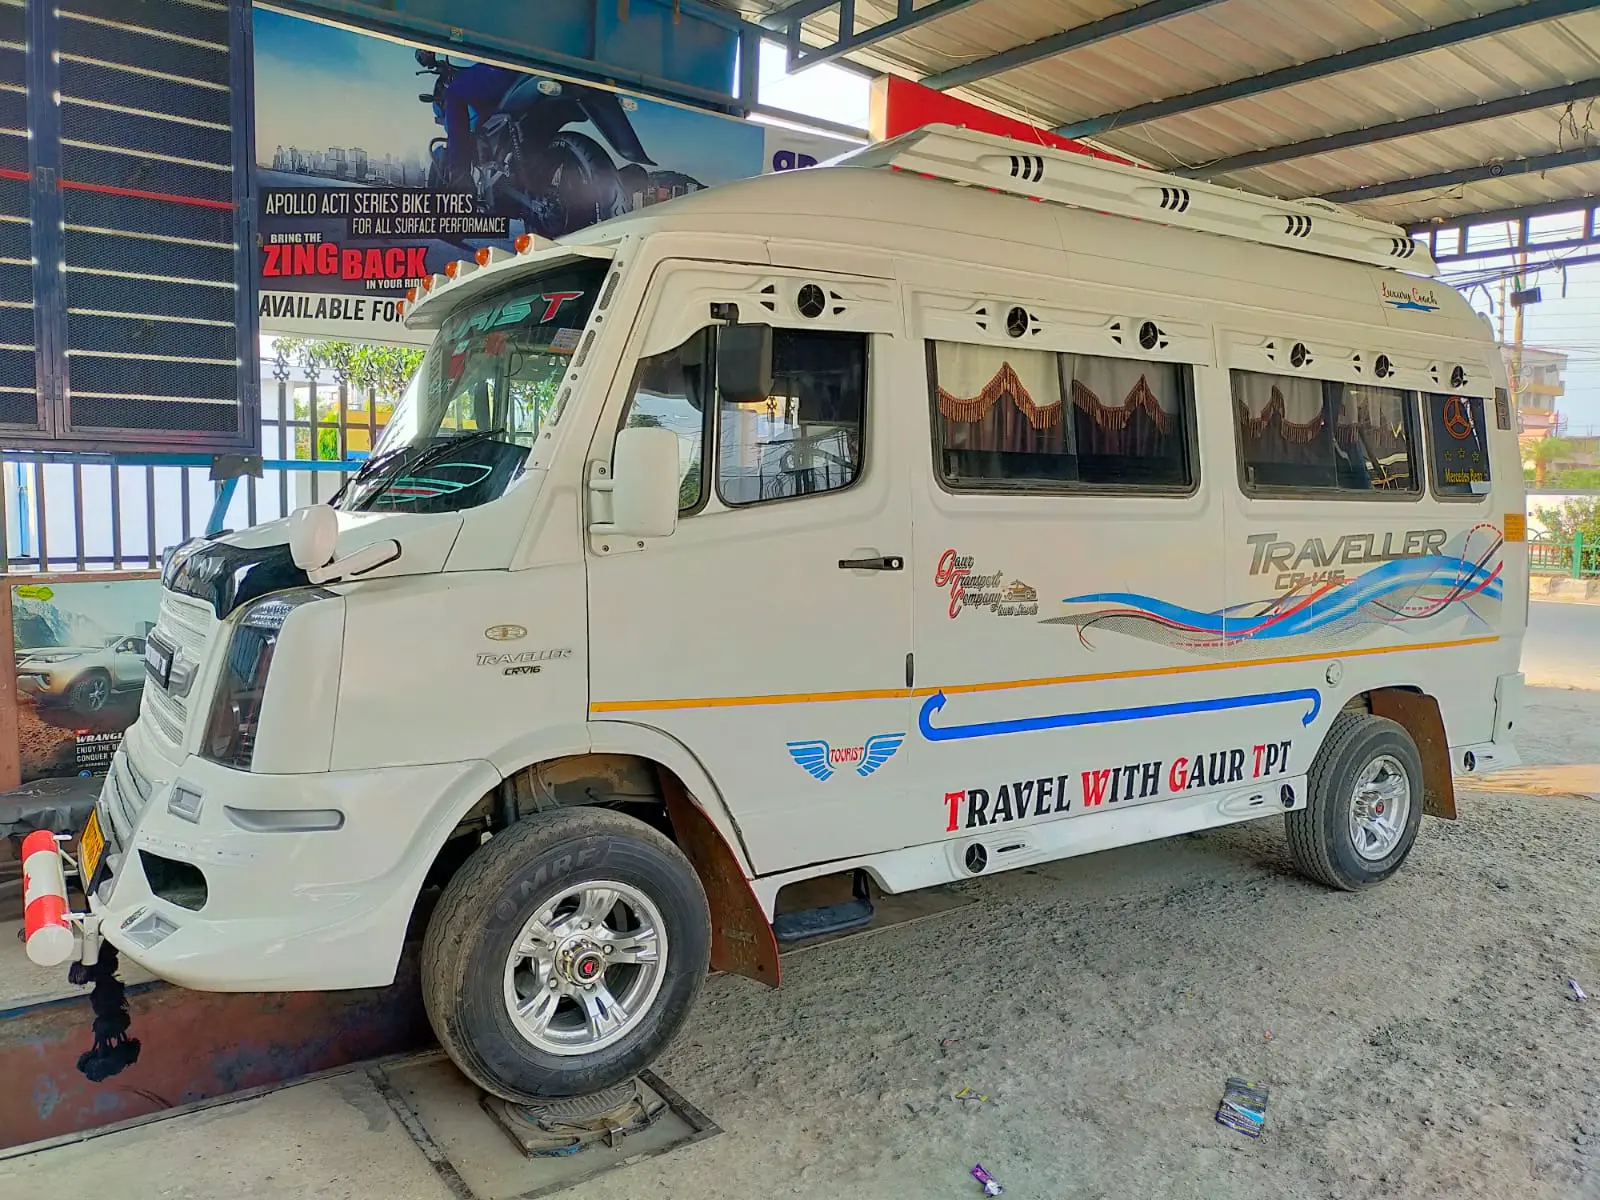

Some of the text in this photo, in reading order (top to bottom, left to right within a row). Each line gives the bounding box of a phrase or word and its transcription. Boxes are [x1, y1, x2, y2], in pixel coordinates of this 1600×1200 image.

[265, 193, 473, 215] APOLLO ACTI SERIES BIKE TYRES
[352, 217, 506, 234] FOR ALL SURFACE PERFORMANCE
[270, 232, 322, 244] BRING THE
[262, 242, 428, 280] ZING BACK
[366, 278, 423, 290] IN YOUR RID
[259, 294, 365, 321] AVAILABLE
[1247, 528, 1448, 576] TRAVELLER
[76, 732, 123, 743] WRANGL
[829, 746, 865, 763] TOURIST
[943, 739, 1293, 832] TRAVEL WITH GAUR TPT
[521, 847, 597, 899] MRF
